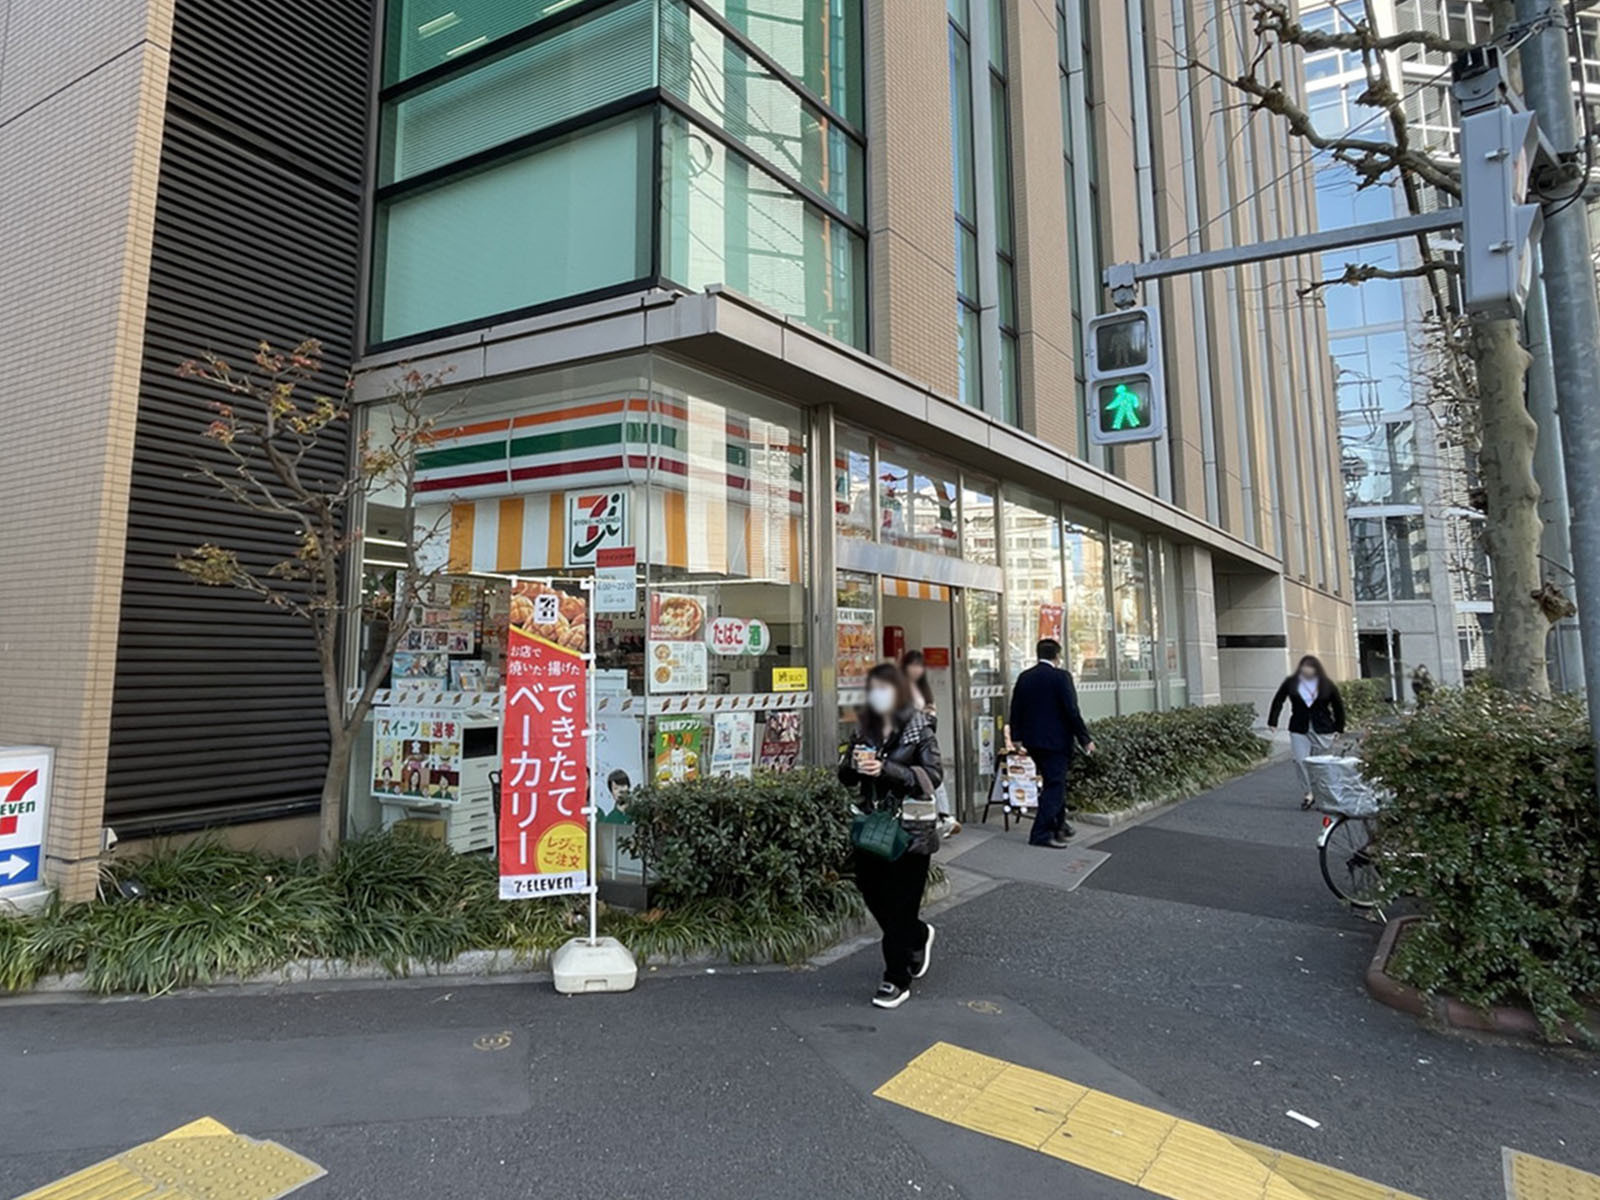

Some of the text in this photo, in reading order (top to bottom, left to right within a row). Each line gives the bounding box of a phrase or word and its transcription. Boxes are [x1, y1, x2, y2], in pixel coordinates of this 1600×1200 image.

[713, 622, 743, 645] たばこ
[748, 624, 761, 646] 酒
[509, 645, 542, 658] お店で
[508, 660, 580, 676] 焼いた・揚げた
[548, 683, 578, 817] できたて
[509, 682, 545, 865] ベーカリー
[547, 836, 584, 853] レジにて
[543, 851, 581, 868] ご注文
